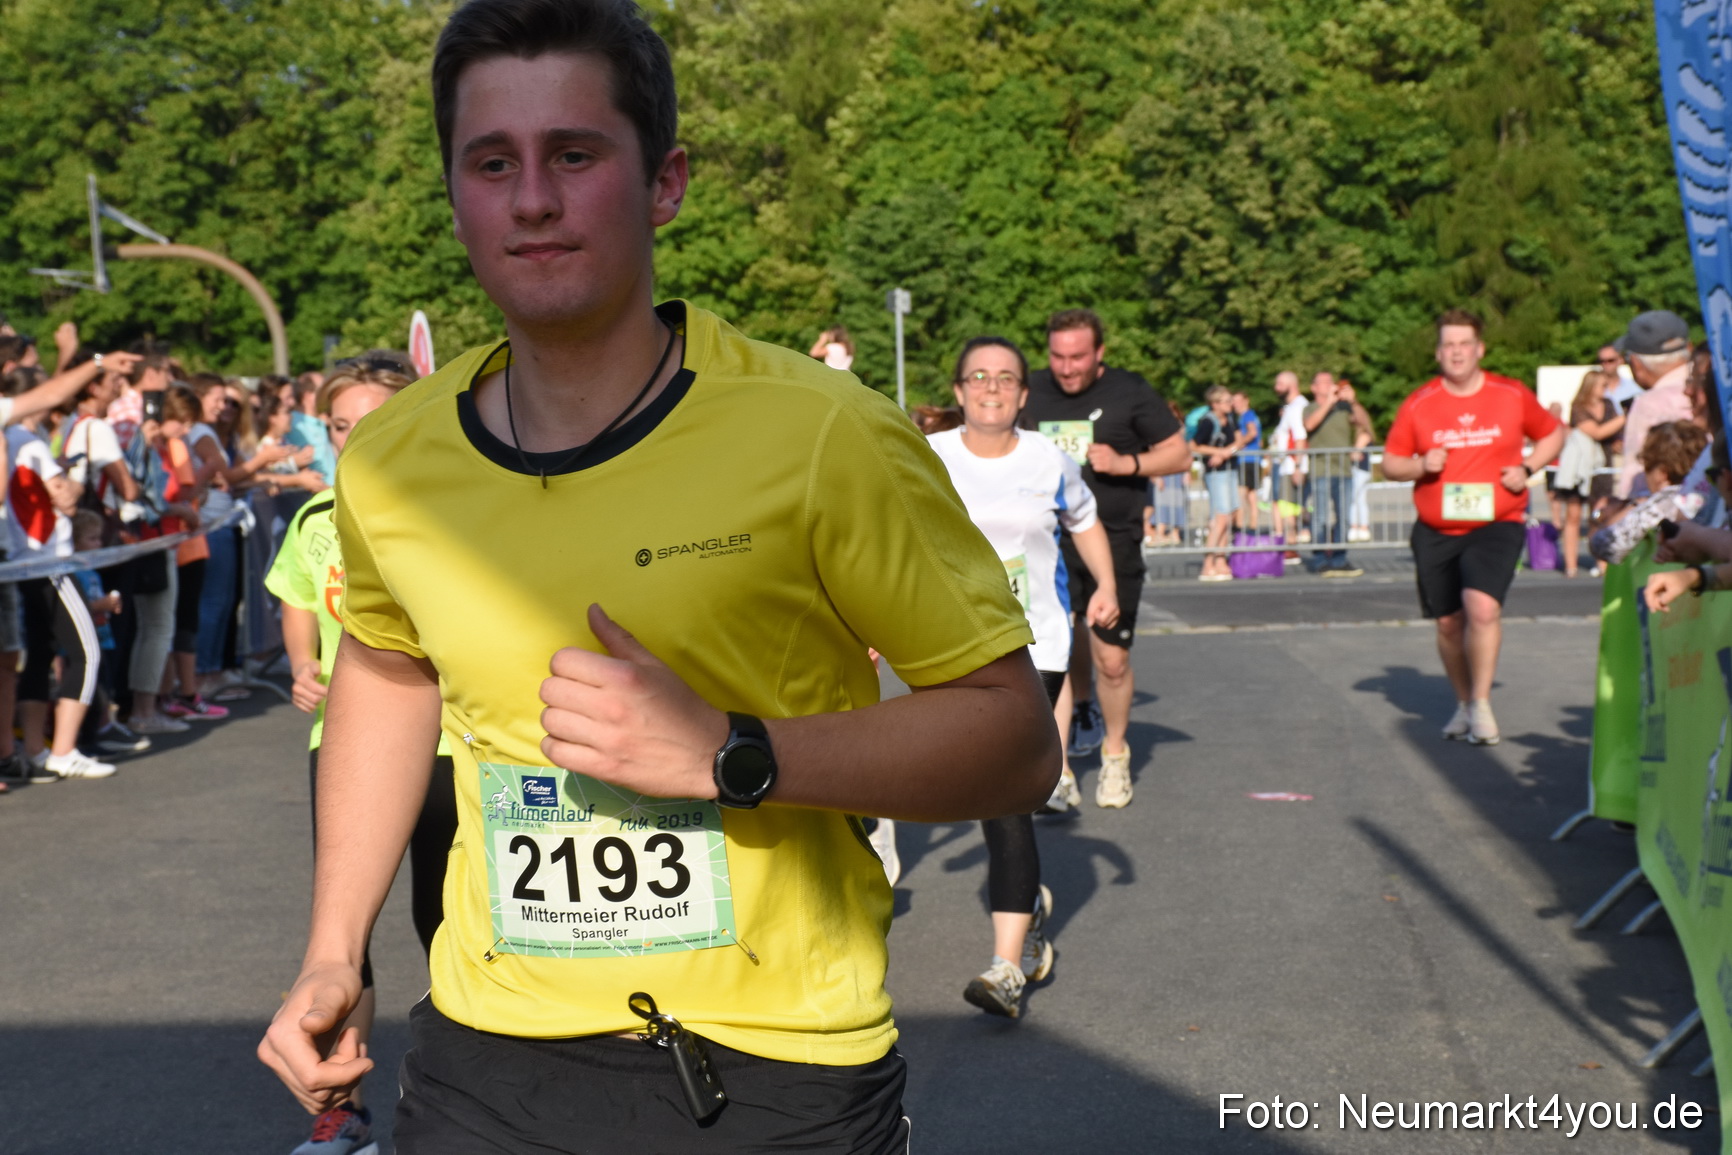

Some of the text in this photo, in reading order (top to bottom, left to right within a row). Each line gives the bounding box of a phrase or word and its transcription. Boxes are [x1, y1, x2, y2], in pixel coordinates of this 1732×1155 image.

[657, 533, 751, 559] SPANGLER
[699, 547, 752, 559] AUTOMATION
[511, 802, 595, 822] firmenlauf
[657, 812, 703, 830] 2019
[509, 833, 691, 903] 2193
[521, 901, 690, 924] Mittermeier Rudolf
[572, 927, 628, 941] Spangler
